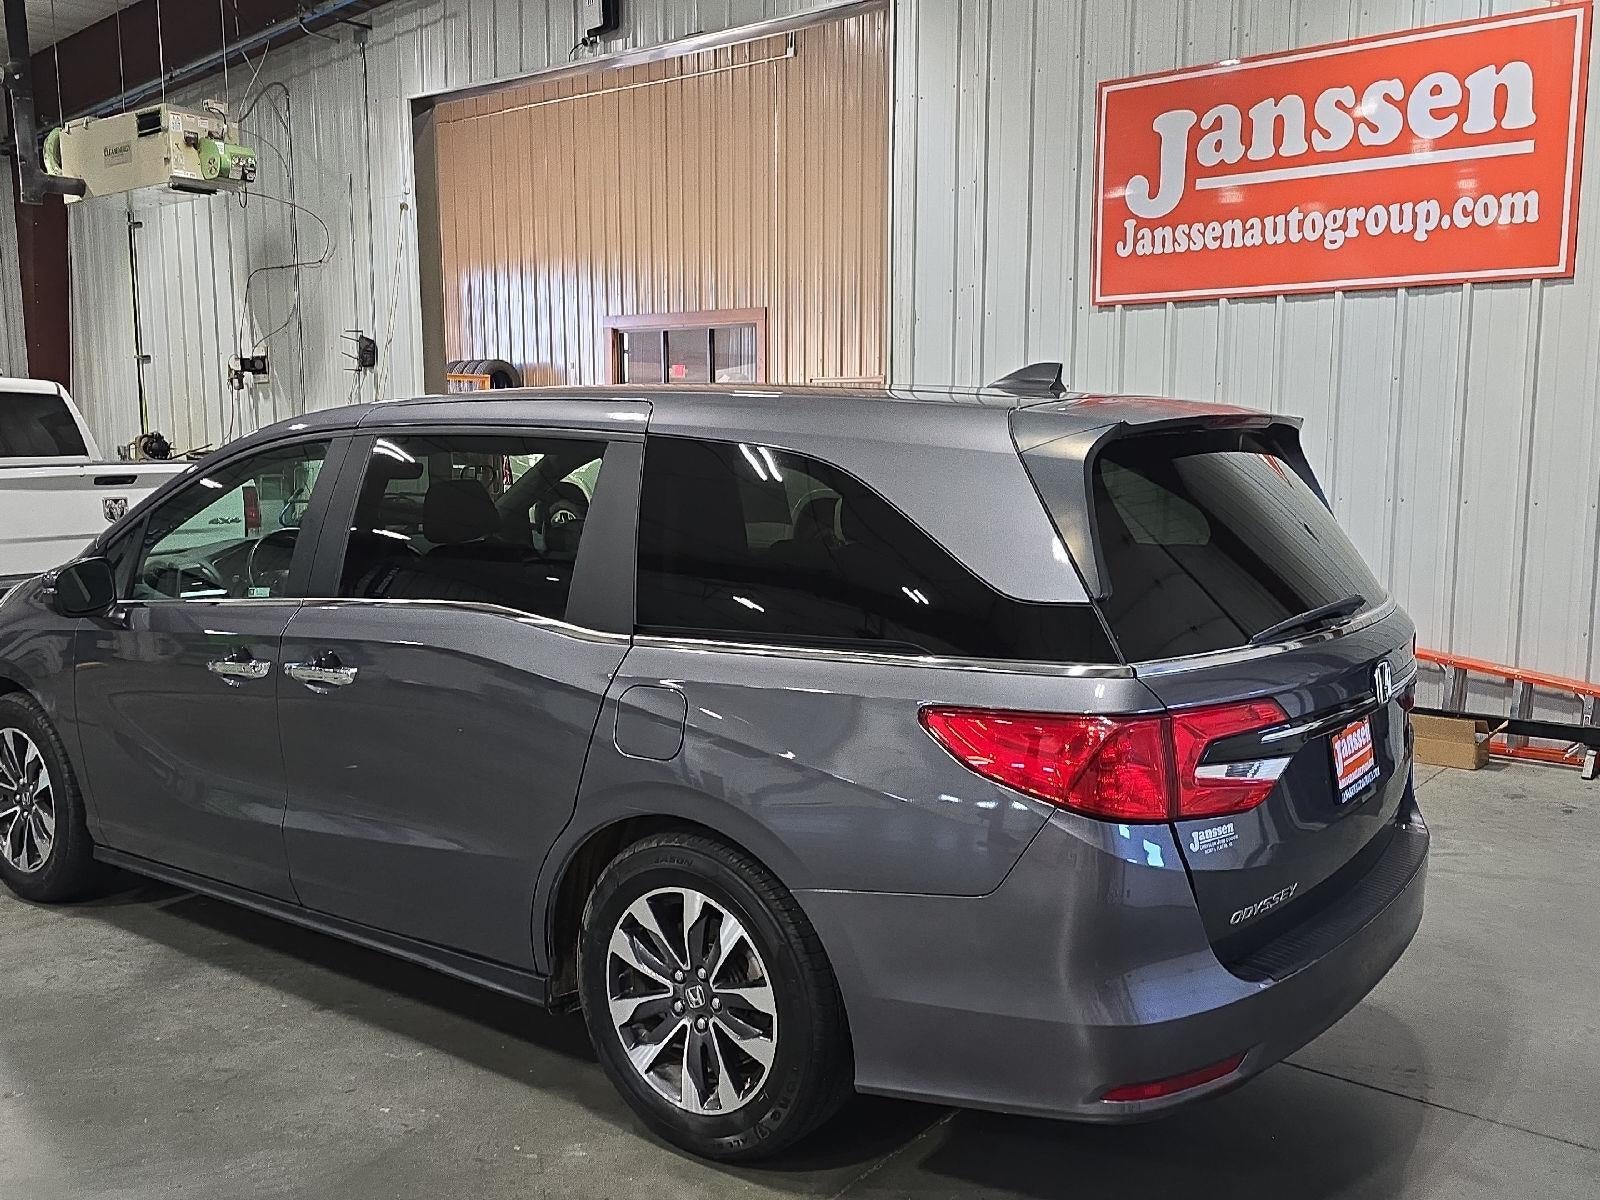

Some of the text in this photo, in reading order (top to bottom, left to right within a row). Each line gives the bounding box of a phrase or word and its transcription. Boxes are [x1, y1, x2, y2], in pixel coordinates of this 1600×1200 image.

[1125, 61, 1537, 219] Janssen
[1116, 188, 1539, 258] Janssenautogroup.com
[1334, 722, 1371, 778] Janssen
[1190, 822, 1234, 852] Janssen
[1230, 882, 1298, 924] ODYSSEY
